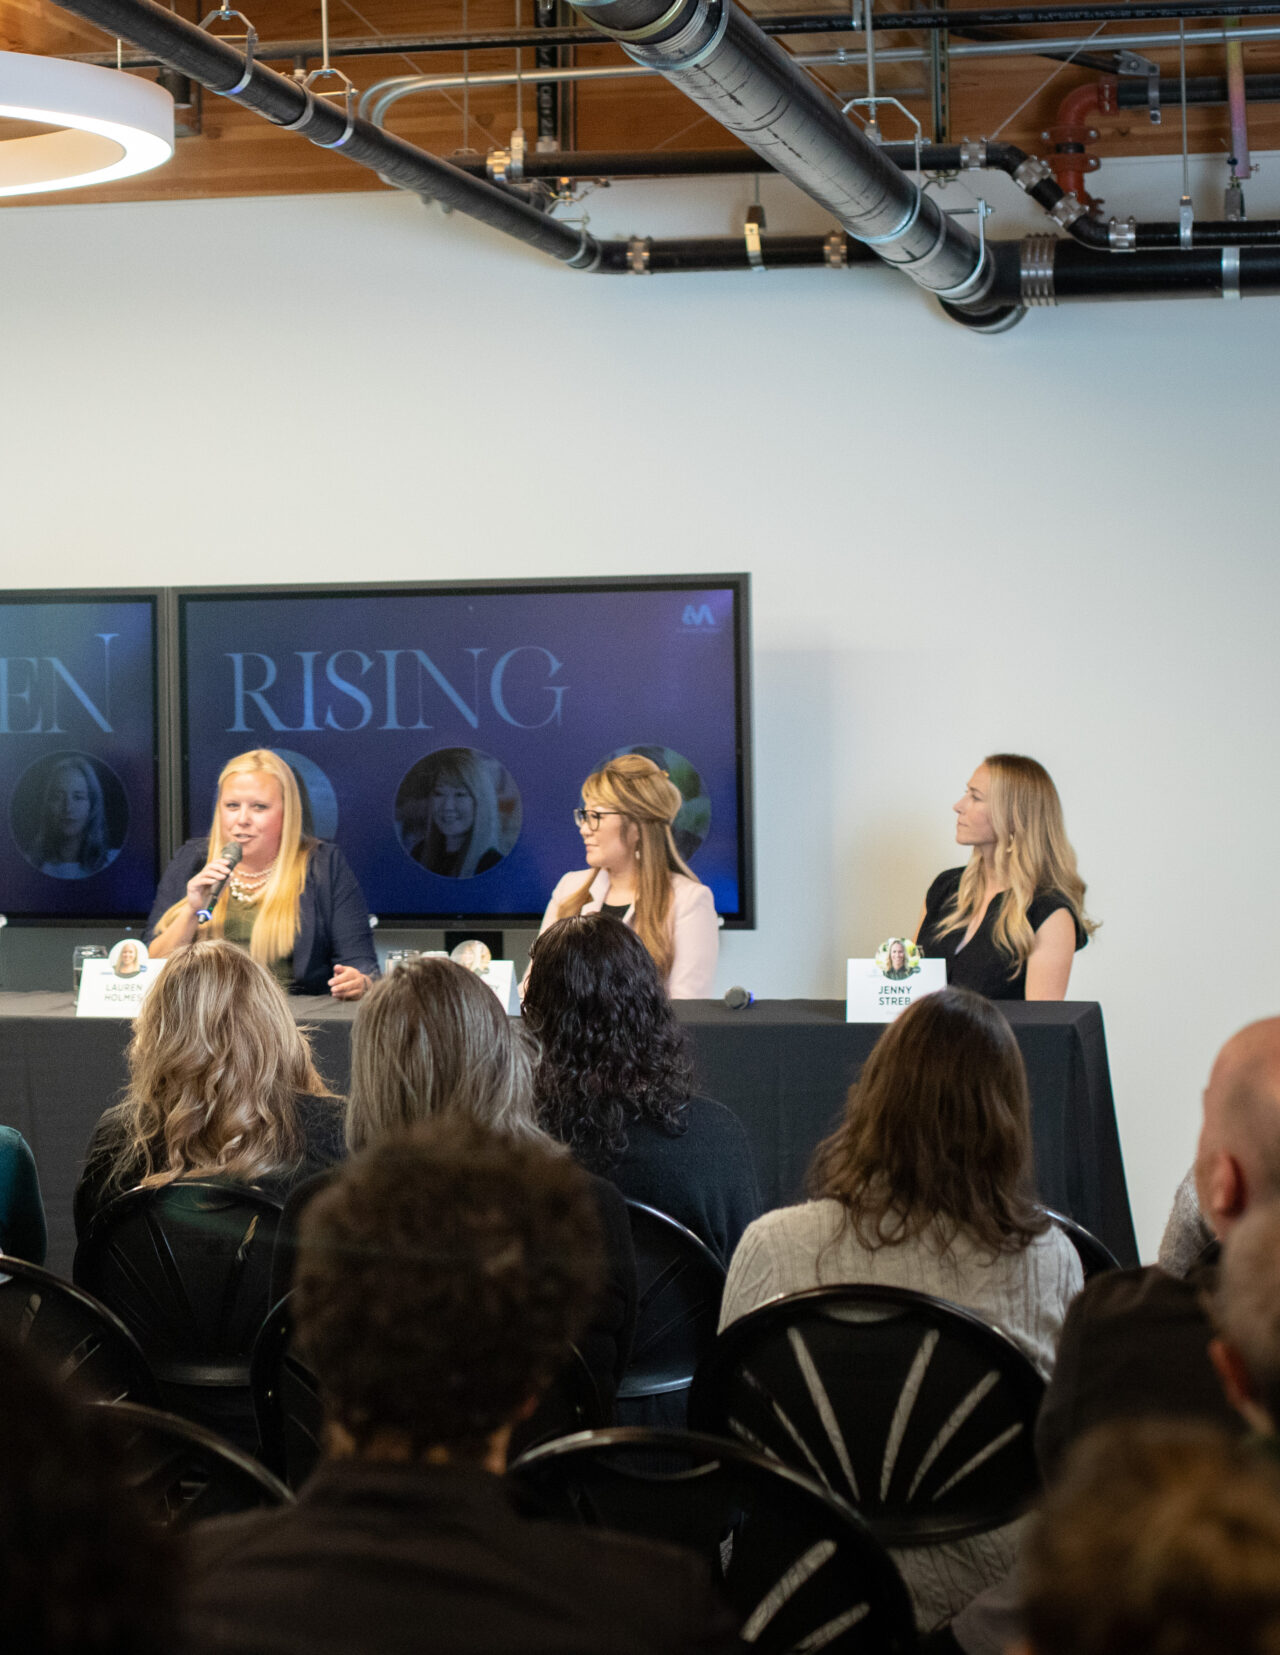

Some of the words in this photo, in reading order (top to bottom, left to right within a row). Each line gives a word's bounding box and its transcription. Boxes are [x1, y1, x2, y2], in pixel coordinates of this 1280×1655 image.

[225, 646, 571, 732] RISING
[105, 984, 143, 992] LAUREN
[878, 985, 913, 995] JENNY
[878, 996, 911, 1006] STREB
